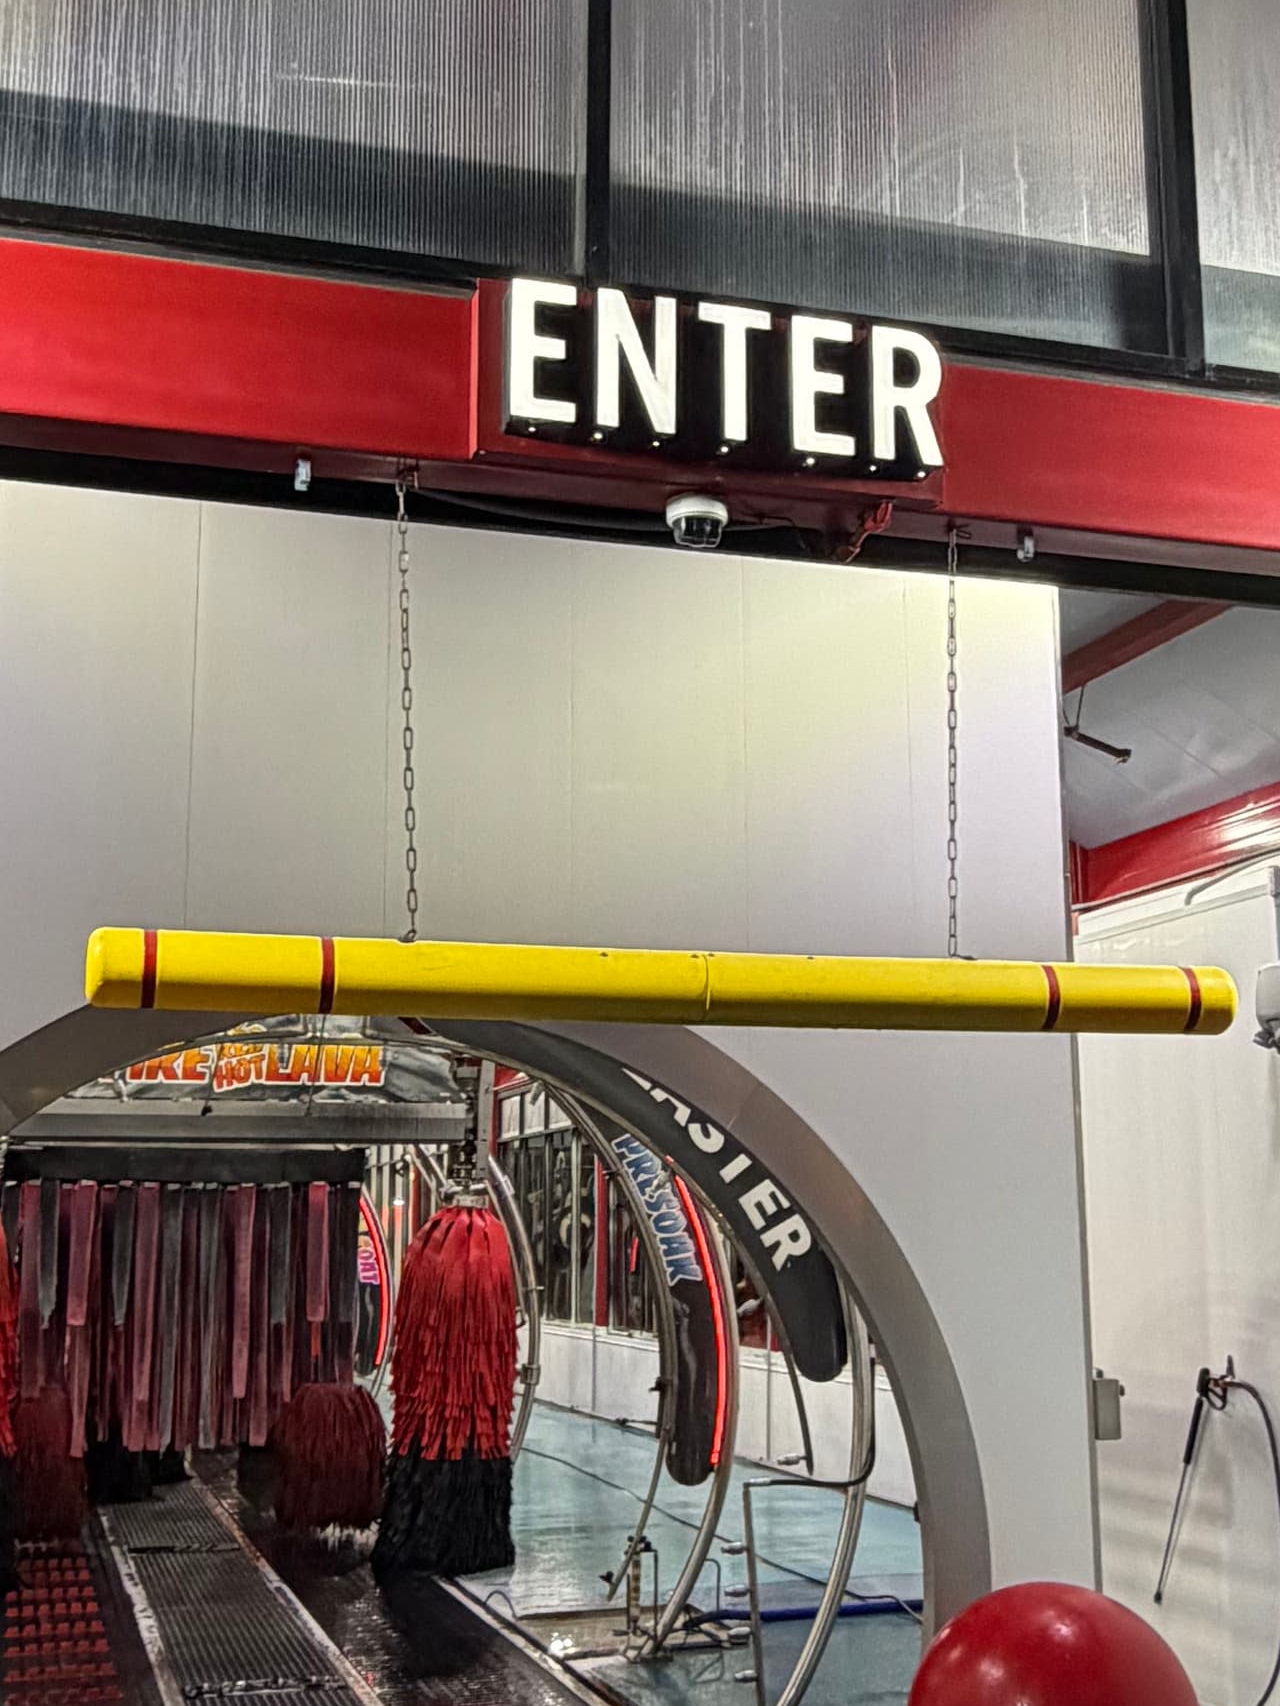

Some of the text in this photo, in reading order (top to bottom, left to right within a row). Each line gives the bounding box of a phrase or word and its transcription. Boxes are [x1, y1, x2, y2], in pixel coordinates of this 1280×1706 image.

[505, 277, 945, 467] ENTER
[214, 1054, 266, 1090] HOT
[265, 1045, 386, 1084] LAVA
